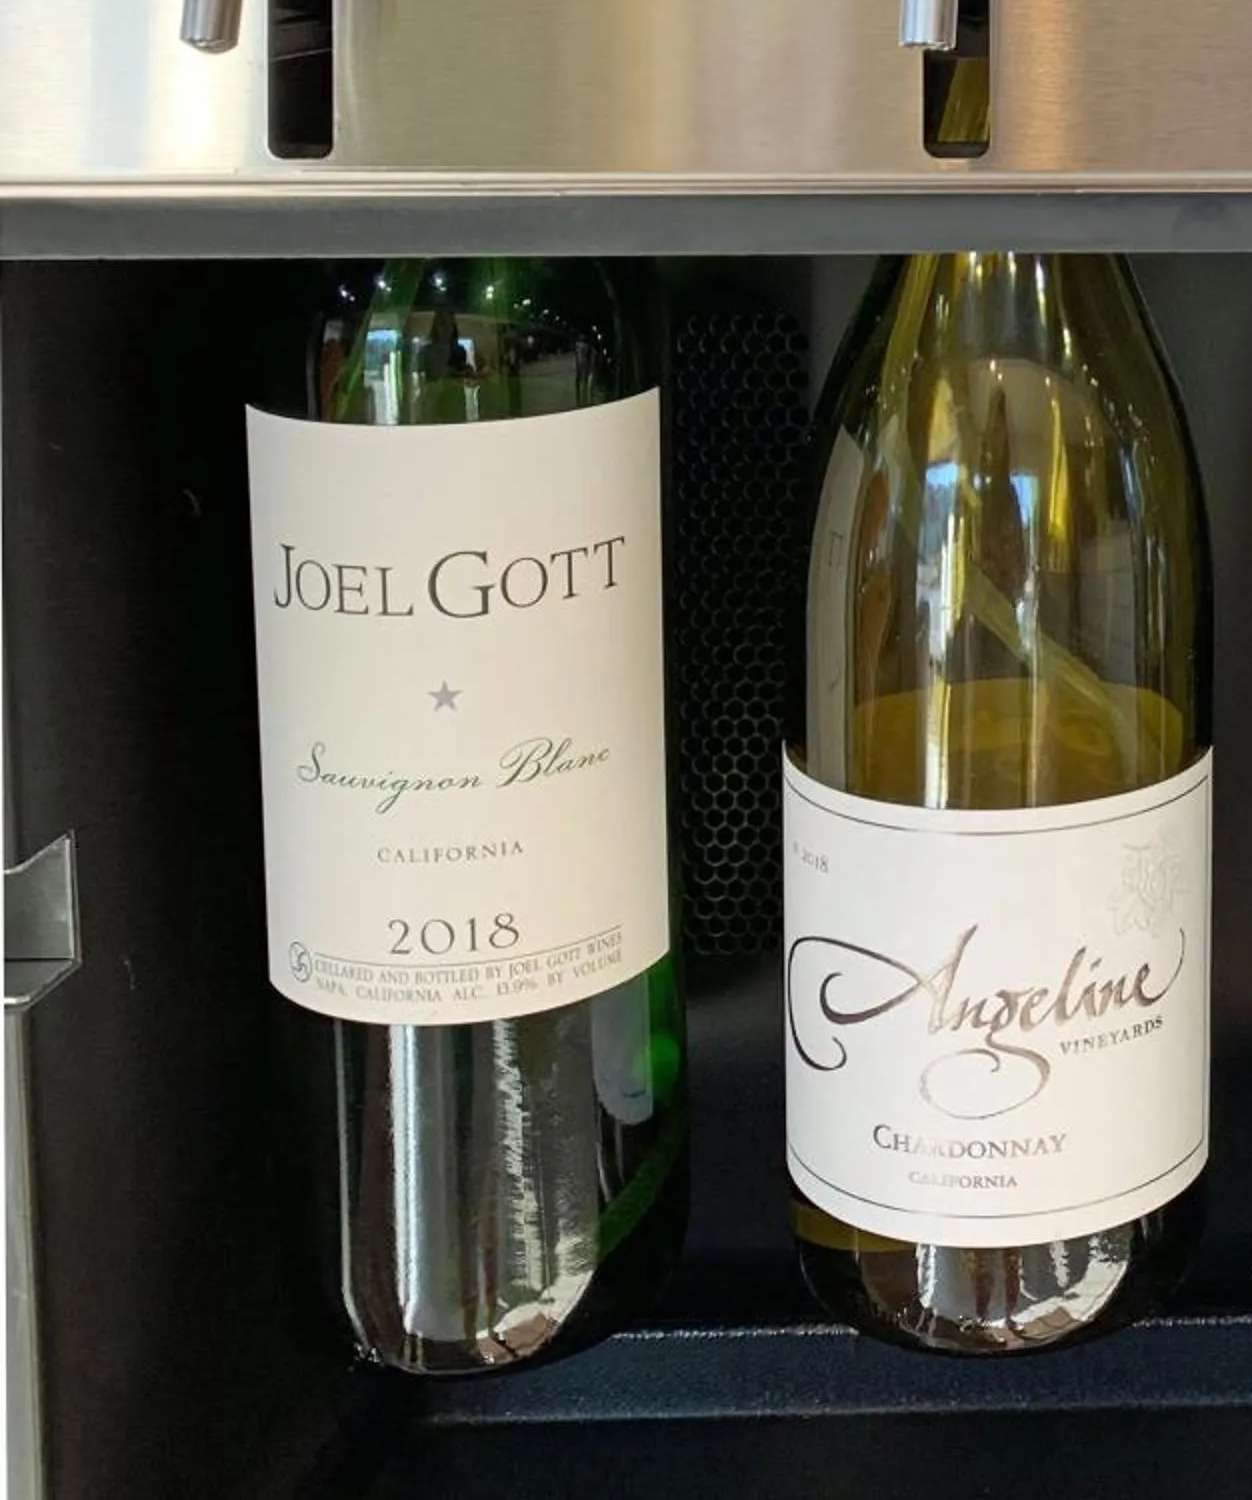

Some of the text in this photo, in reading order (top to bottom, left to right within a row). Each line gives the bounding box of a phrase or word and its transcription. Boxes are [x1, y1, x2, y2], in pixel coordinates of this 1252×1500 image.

[274, 536, 626, 618] JOEL GOTT
[297, 736, 611, 815] Sauvignon Blanc
[377, 840, 524, 864] CALIFORNIA
[388, 913, 520, 955] 2018
[378, 970, 409, 985] AND
[415, 967, 479, 985] BOTTLED
[485, 966, 501, 980] BY
[509, 959, 540, 979] JOEL
[546, 947, 580, 967] GOTT
[356, 984, 442, 1002] CALIFORNIA
[547, 971, 563, 986] BY
[1059, 1015, 1164, 1055] VINEYARDS
